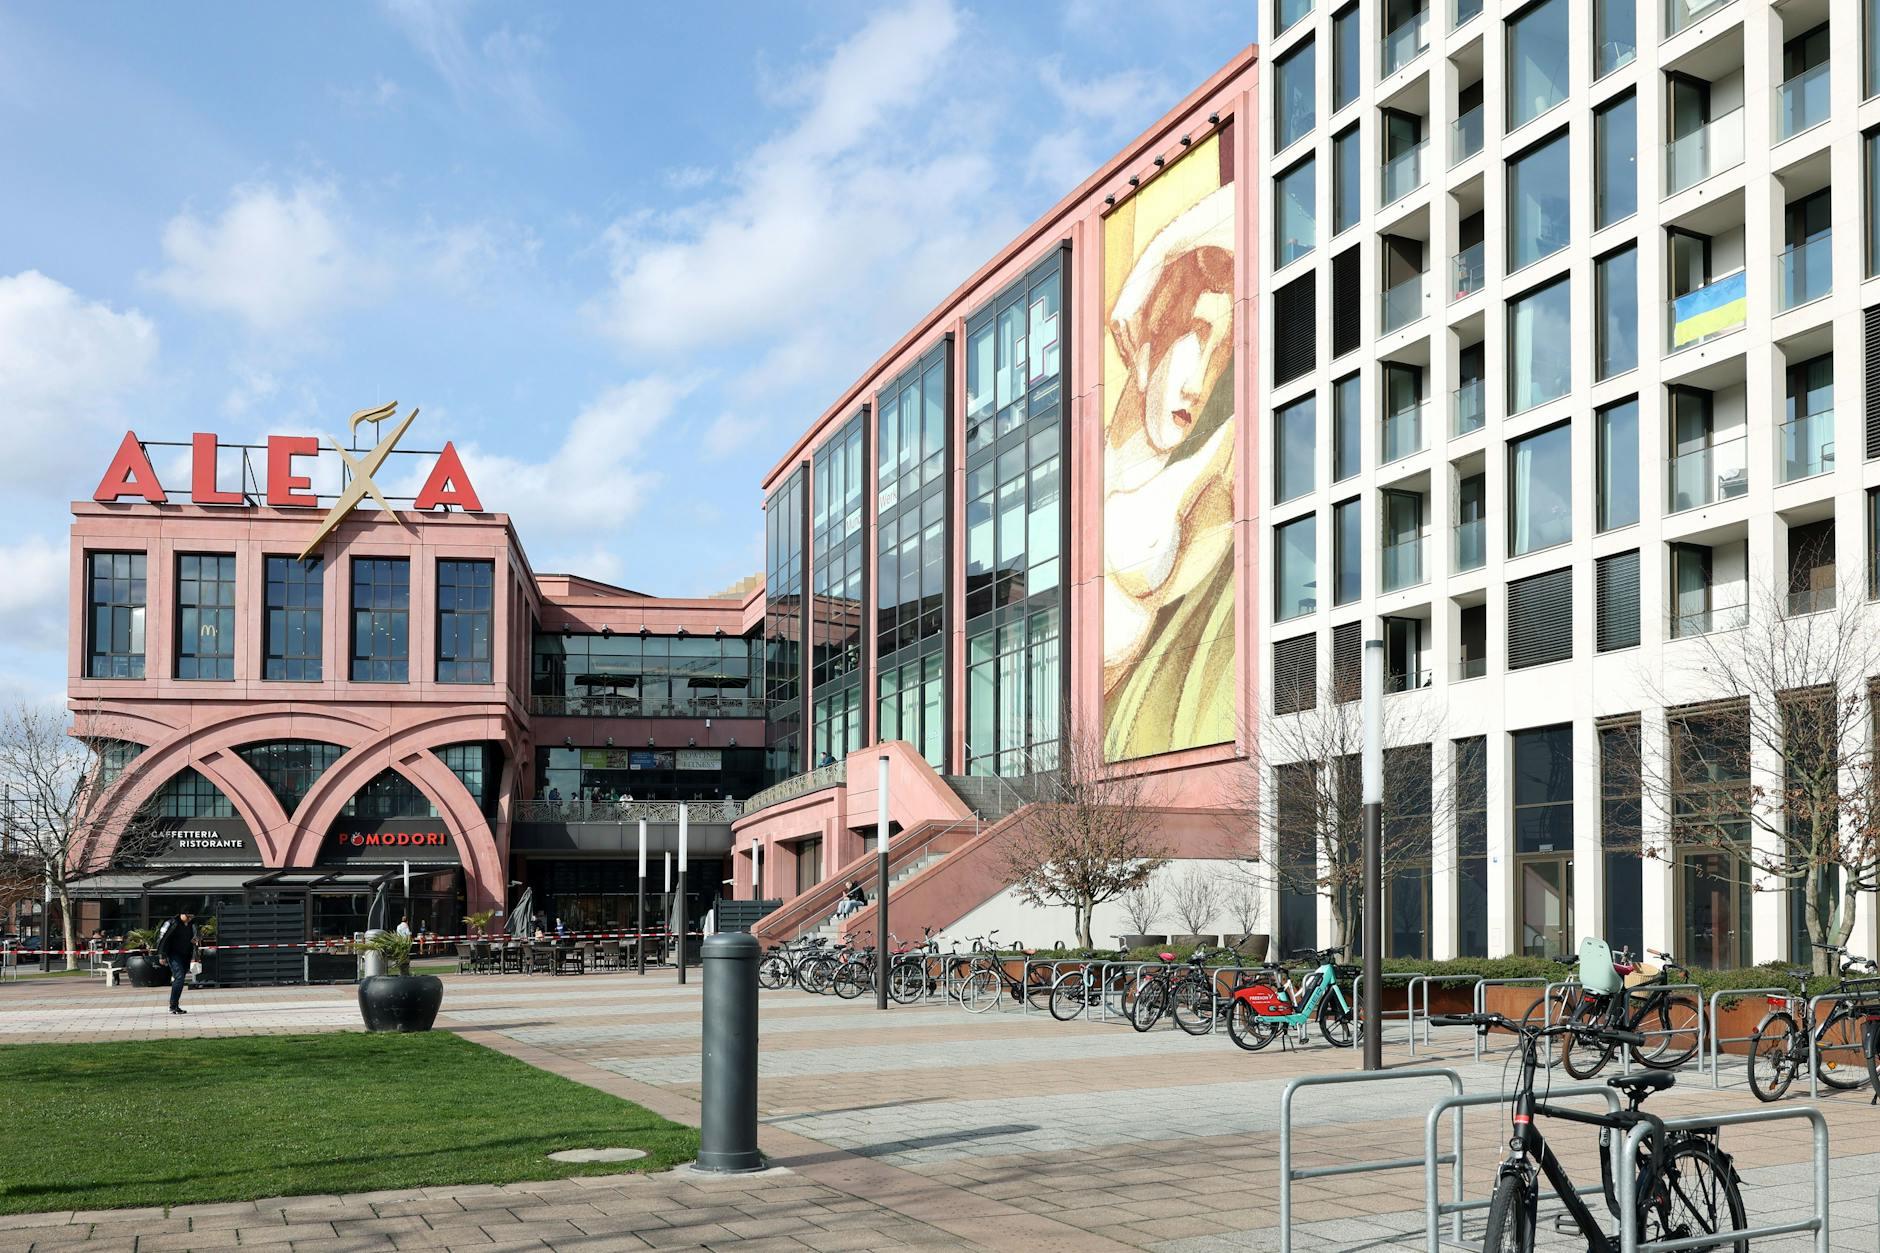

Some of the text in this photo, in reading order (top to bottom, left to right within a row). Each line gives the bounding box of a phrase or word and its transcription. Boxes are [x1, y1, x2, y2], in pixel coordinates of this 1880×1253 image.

[93, 408, 483, 560] ALEXA
[180, 840, 243, 848] RISTORANTE
[339, 832, 445, 846] POMODORI
[1306, 988, 1322, 1011] TIER
